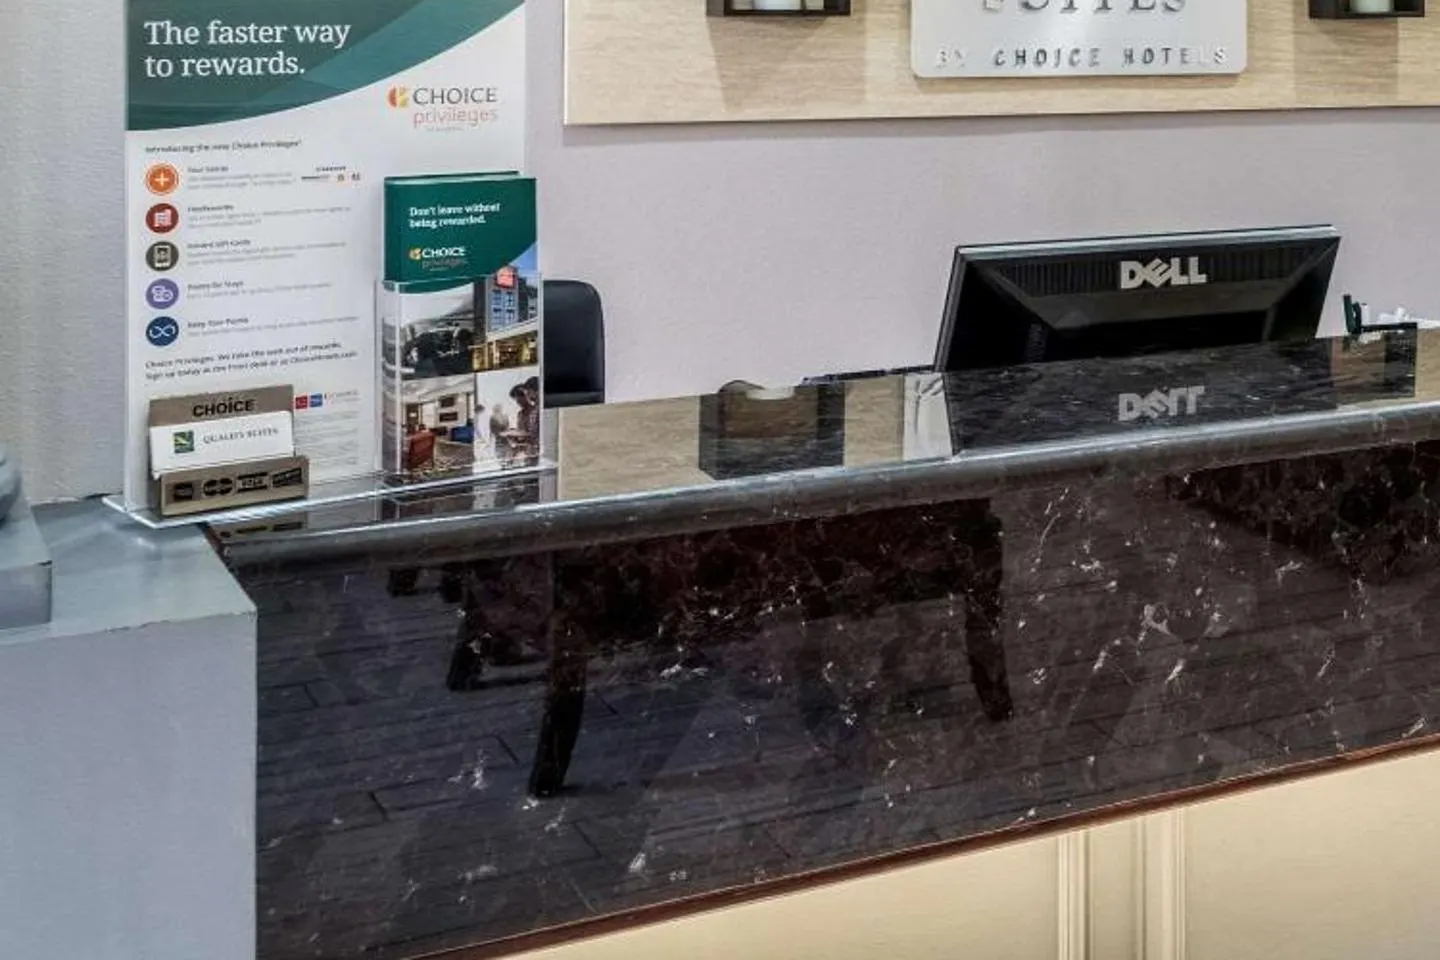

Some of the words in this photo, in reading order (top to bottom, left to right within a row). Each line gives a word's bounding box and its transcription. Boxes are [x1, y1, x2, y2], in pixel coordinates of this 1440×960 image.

[144, 19, 200, 45] The
[207, 19, 288, 45] faster
[294, 23, 352, 49] way
[144, 56, 174, 78] to
[180, 50, 306, 77] rewards.
[993, 47, 1103, 69] CHOICE
[413, 86, 498, 105] CHOICE
[414, 107, 499, 129] privileges
[409, 205, 436, 218] Don't
[437, 203, 464, 216] leave
[409, 218, 437, 230] being
[421, 246, 467, 259] CHOICE
[1120, 256, 1206, 289] DELL
[193, 397, 256, 418] CHOICE
